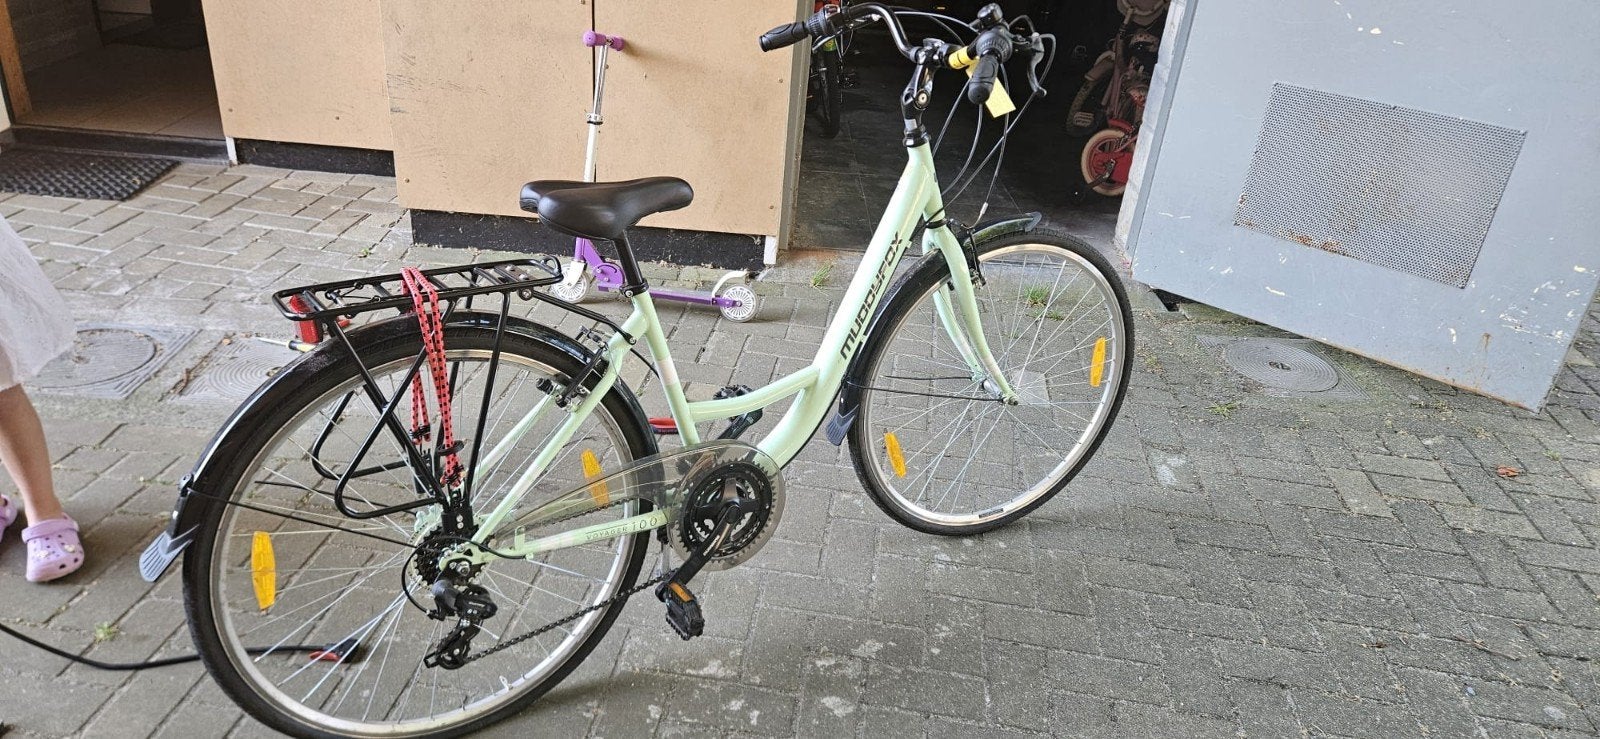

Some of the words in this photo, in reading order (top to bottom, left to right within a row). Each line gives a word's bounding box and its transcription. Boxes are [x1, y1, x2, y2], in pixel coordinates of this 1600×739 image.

[840, 231, 903, 360] MUDDYFOX
[586, 526, 628, 540] VOYAGER
[632, 516, 658, 530] 100
